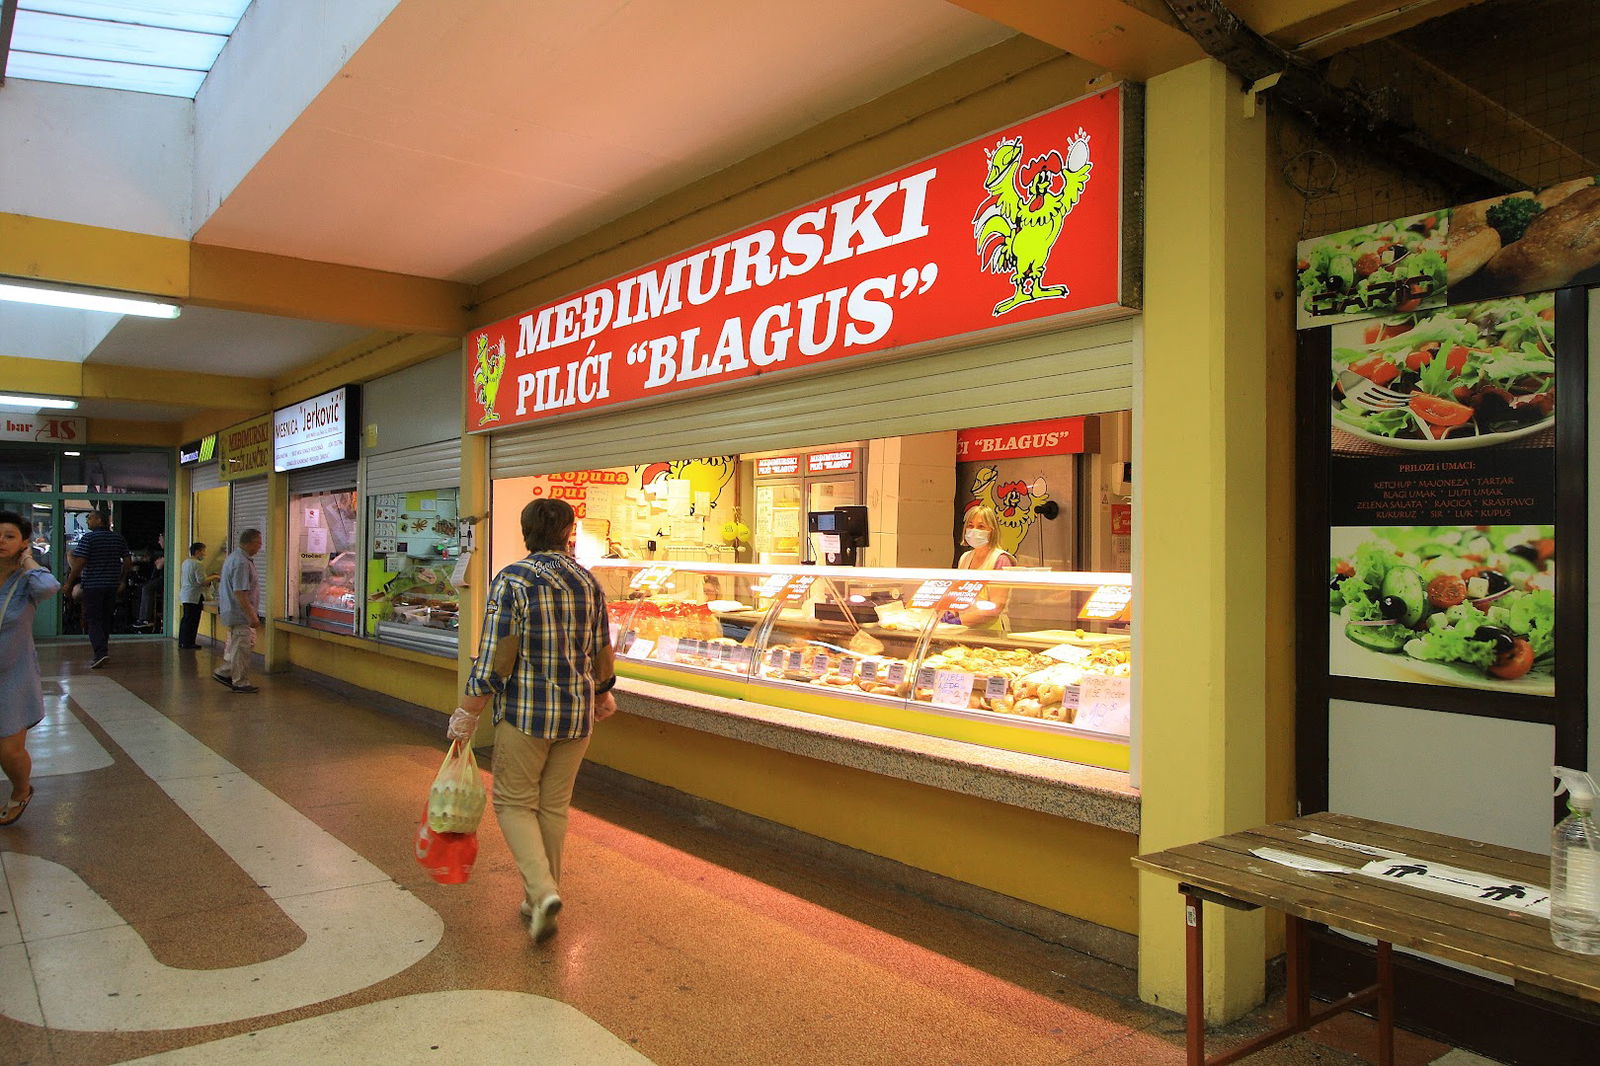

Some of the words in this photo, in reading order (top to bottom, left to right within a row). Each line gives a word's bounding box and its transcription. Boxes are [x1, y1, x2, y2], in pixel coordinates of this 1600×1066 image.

[515, 168, 937, 359] MEĐIMURSKI
[515, 339, 612, 416] PILIĆI
[626, 262, 938, 389] “BLAGUS”
[6, 420, 33, 432] bar
[35, 420, 76, 441] AS
[975, 431, 1069, 452] “BLAGUS”
[1400, 463, 1435, 472] PRILOZI
[1441, 461, 1476, 471] UMACI:
[1374, 481, 1412, 489] KETCHUP
[1418, 479, 1469, 488] MAJONEZA
[1477, 477, 1514, 486] TARTAR
[1409, 490, 1436, 498] UMAK
[1473, 488, 1503, 496] UMAK
[1357, 501, 1388, 510] ZELENA
[1389, 500, 1423, 509] SALATA
[1376, 510, 1417, 519] KUKURUZ
[1455, 510, 1473, 518] LUK
[1480, 509, 1511, 517] KUPUS
